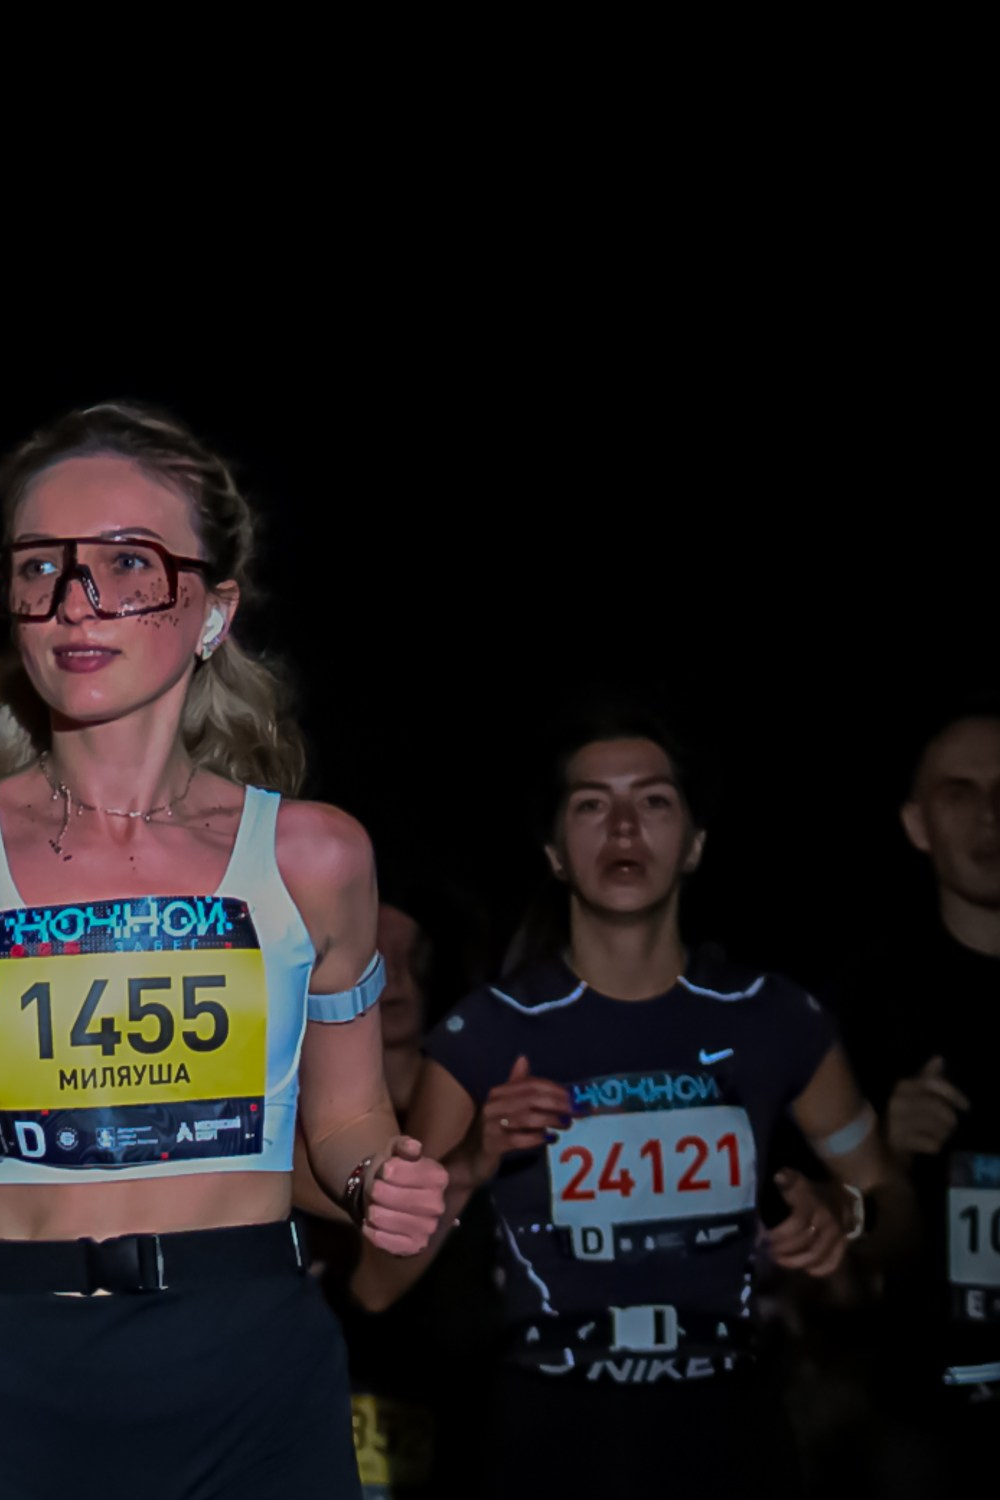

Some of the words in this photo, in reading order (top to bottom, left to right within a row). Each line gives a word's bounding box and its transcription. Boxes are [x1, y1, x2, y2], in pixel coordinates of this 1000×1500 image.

[20, 975, 230, 1060] 1455
[59, 1063, 190, 1091] МИЛЯУША
[14, 1120, 47, 1158] D
[559, 1132, 741, 1201] 24121
[580, 1227, 604, 1255] D
[586, 1356, 715, 1383] NIKE
